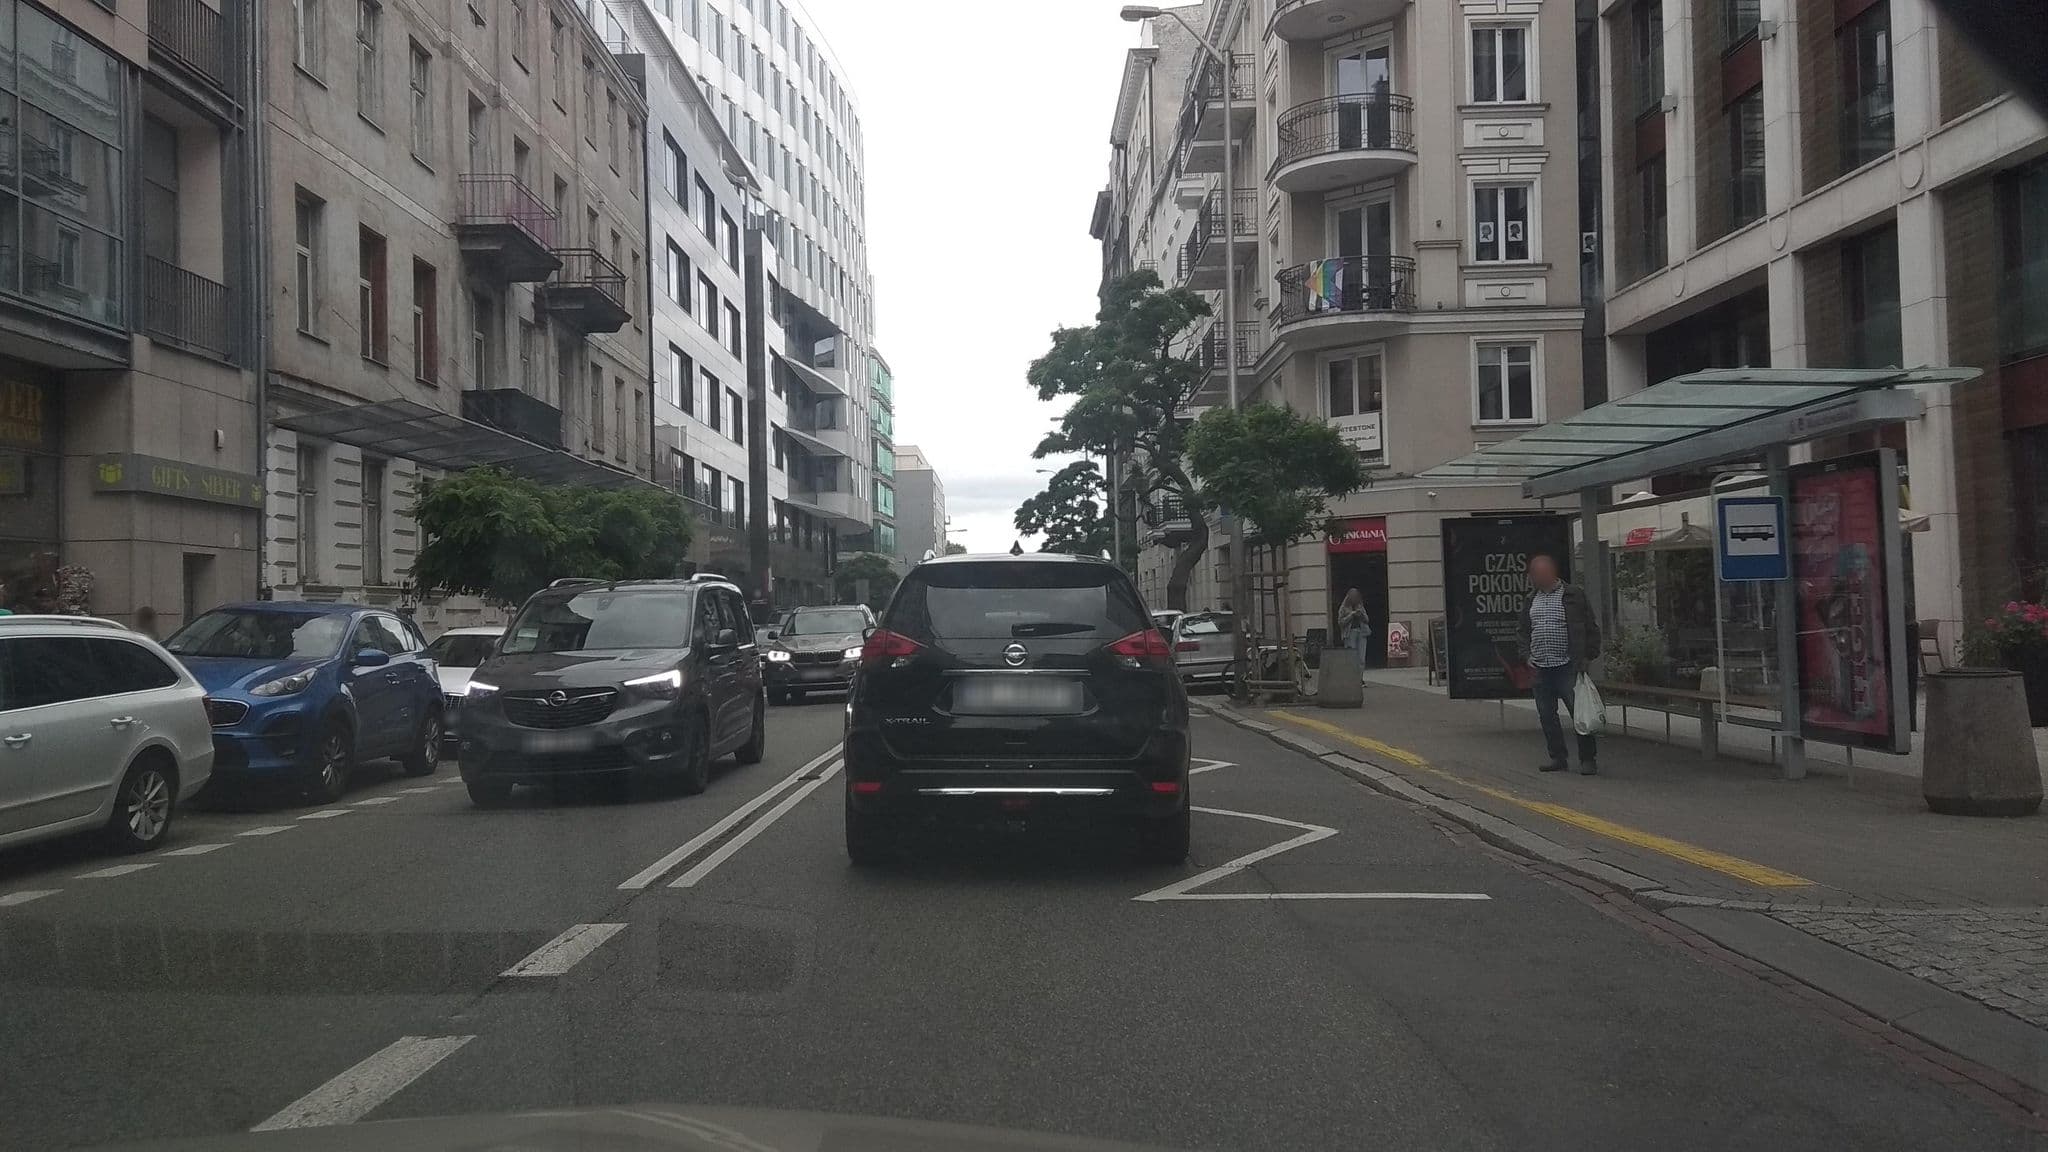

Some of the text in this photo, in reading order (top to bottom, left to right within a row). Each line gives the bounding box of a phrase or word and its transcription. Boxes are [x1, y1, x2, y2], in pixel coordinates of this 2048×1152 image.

[151, 464, 241, 500] GIFTS SILVER
[1485, 552, 1527, 573] CZAS
[1468, 573, 1534, 593] POKONA
[1476, 594, 1523, 614] SMOG
